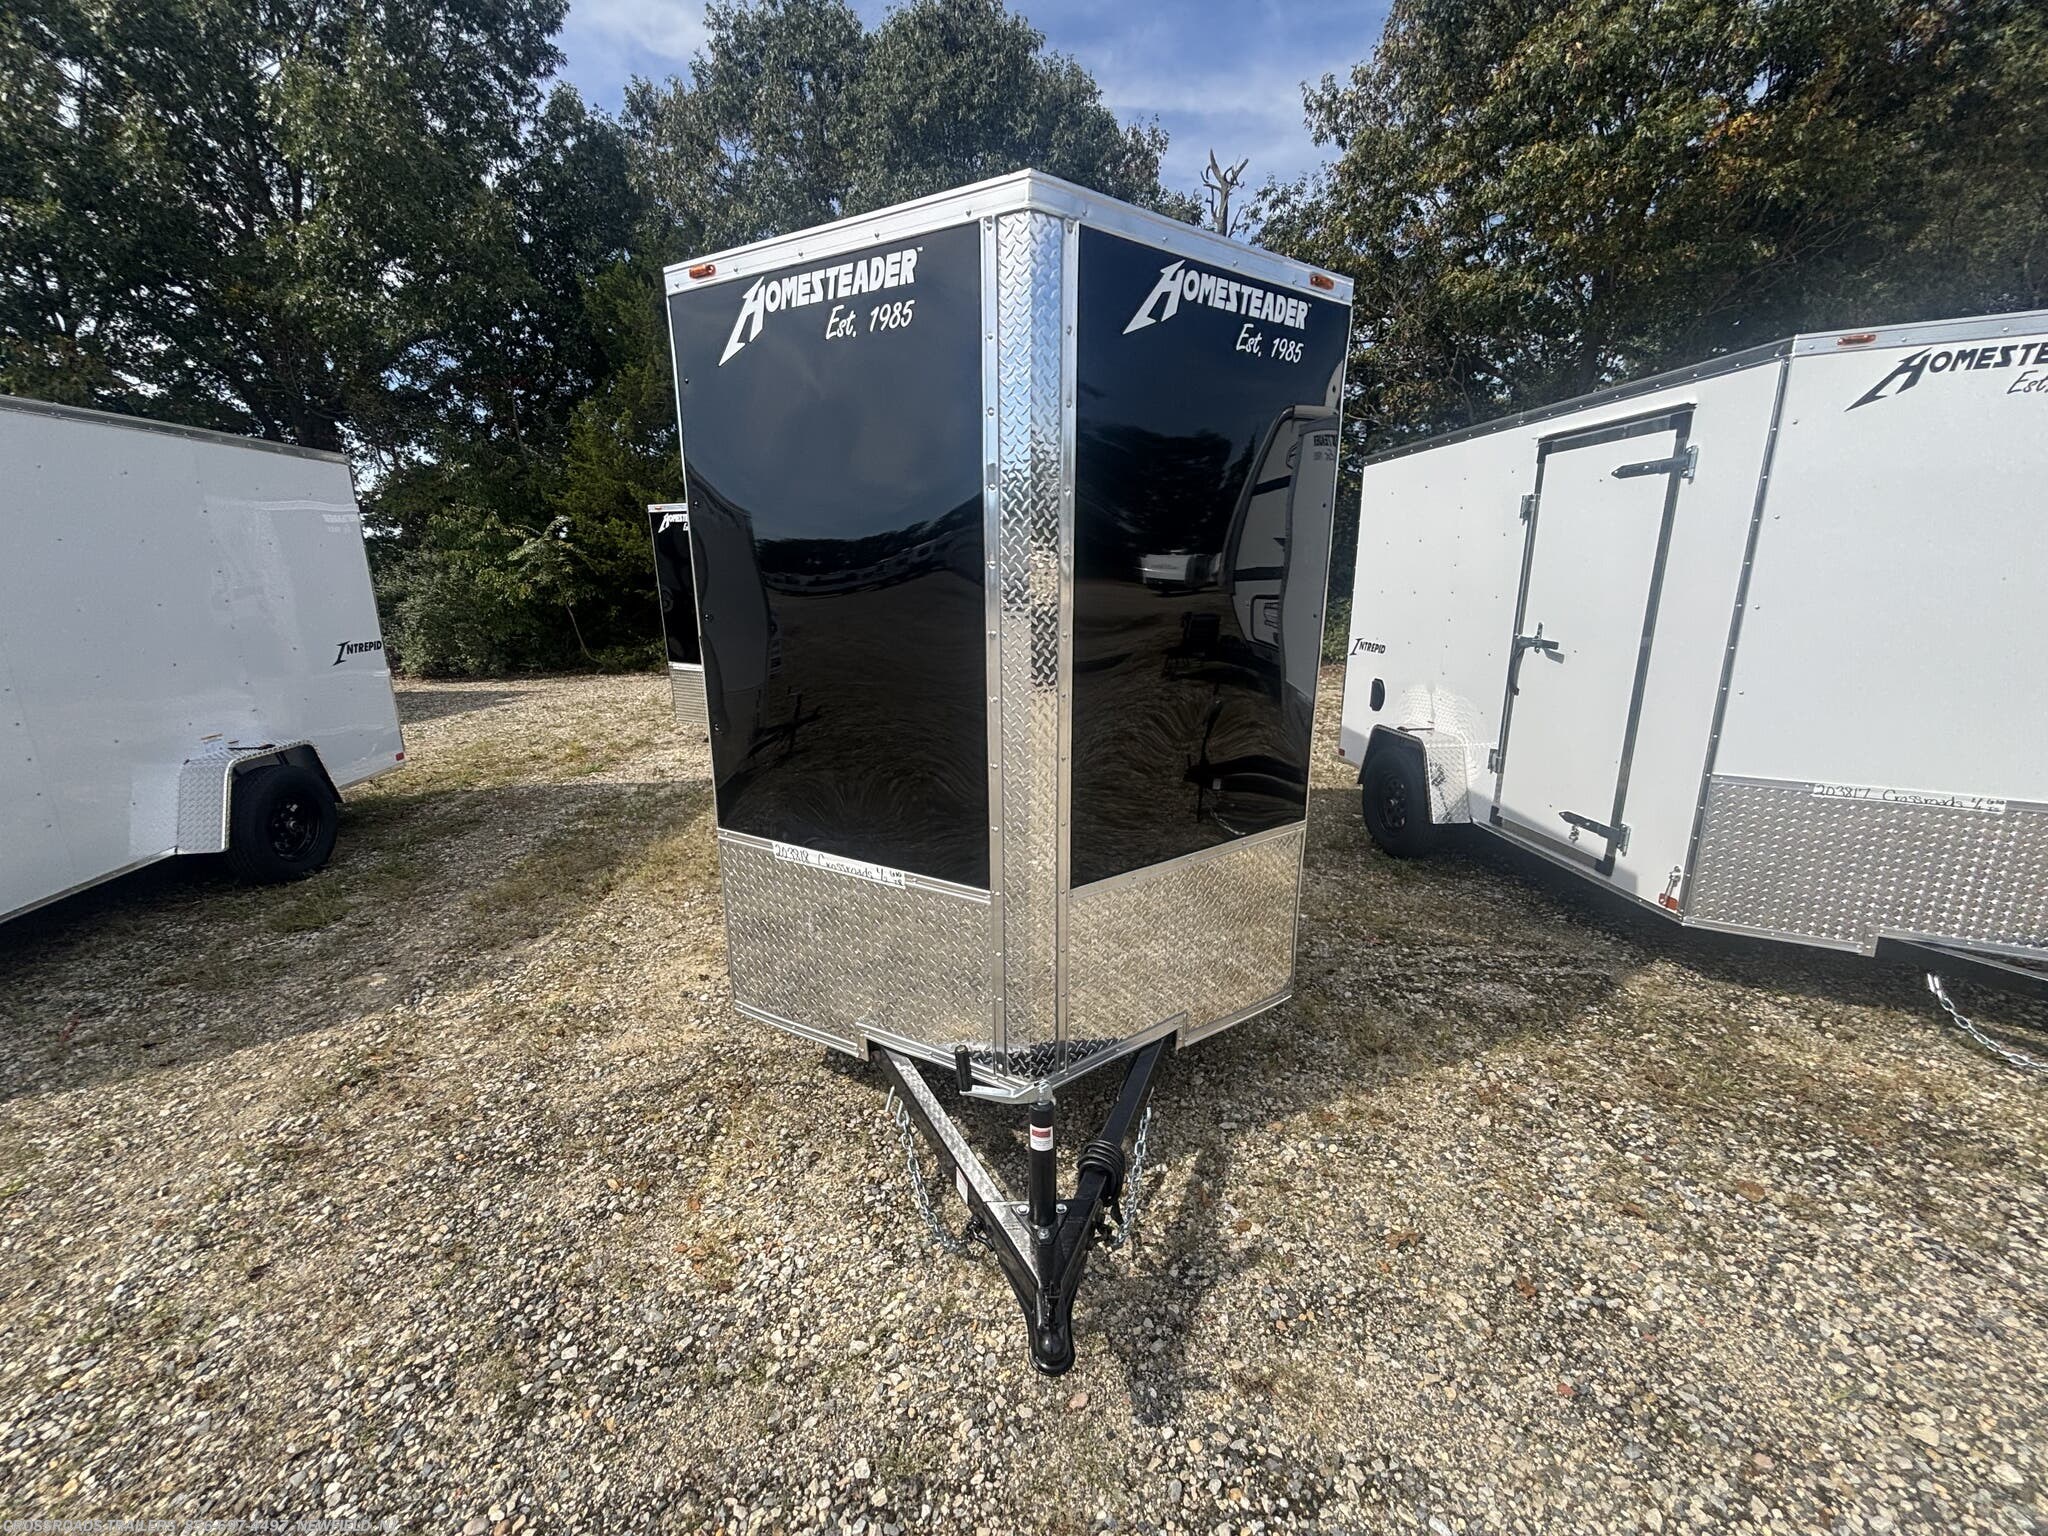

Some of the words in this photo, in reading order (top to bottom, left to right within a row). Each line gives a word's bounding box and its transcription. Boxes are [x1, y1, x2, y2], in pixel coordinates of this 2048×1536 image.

[719, 247, 918, 367] HOMESTEADER
[1122, 259, 1308, 335] HOMESTEADER
[869, 299, 915, 333] 1985
[1271, 337, 1305, 364] 1985
[332, 640, 383, 667] INTREPID
[1349, 637, 1386, 656] INTREPID
